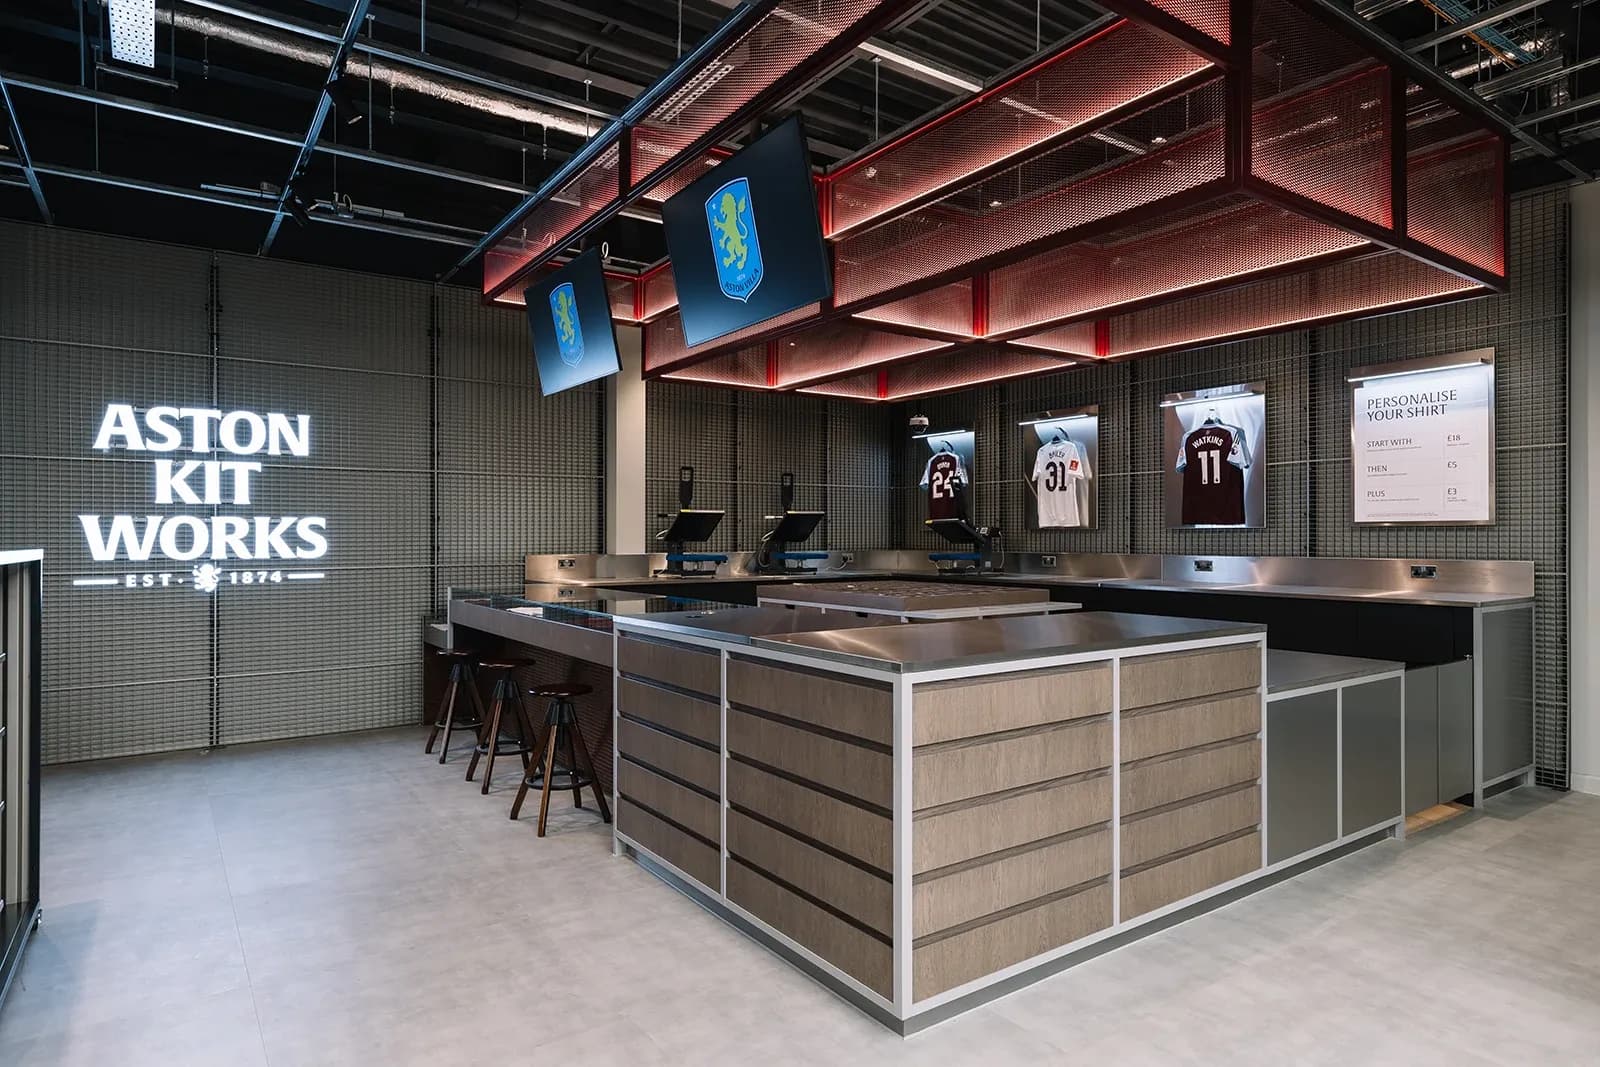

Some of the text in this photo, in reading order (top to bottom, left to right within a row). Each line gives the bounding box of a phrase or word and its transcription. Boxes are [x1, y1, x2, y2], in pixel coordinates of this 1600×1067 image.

[1367, 389, 1457, 410] PERSONALISE
[1367, 404, 1448, 422] YOUR SHIRT
[92, 403, 310, 457] ASTON
[1447, 434, 1461, 442] £18
[1192, 435, 1224, 449] WATKINS
[1366, 438, 1412, 448] START WITH
[1198, 450, 1221, 485] 11
[1367, 465, 1388, 473] THEN
[1447, 461, 1457, 469] £5
[154, 459, 262, 504] KIT
[932, 470, 954, 499] 24
[1045, 461, 1067, 492] 31
[1367, 490, 1386, 498] PLUS
[1447, 488, 1457, 496] £3
[78, 515, 328, 561] WORKS
[229, 571, 283, 584] 1874
